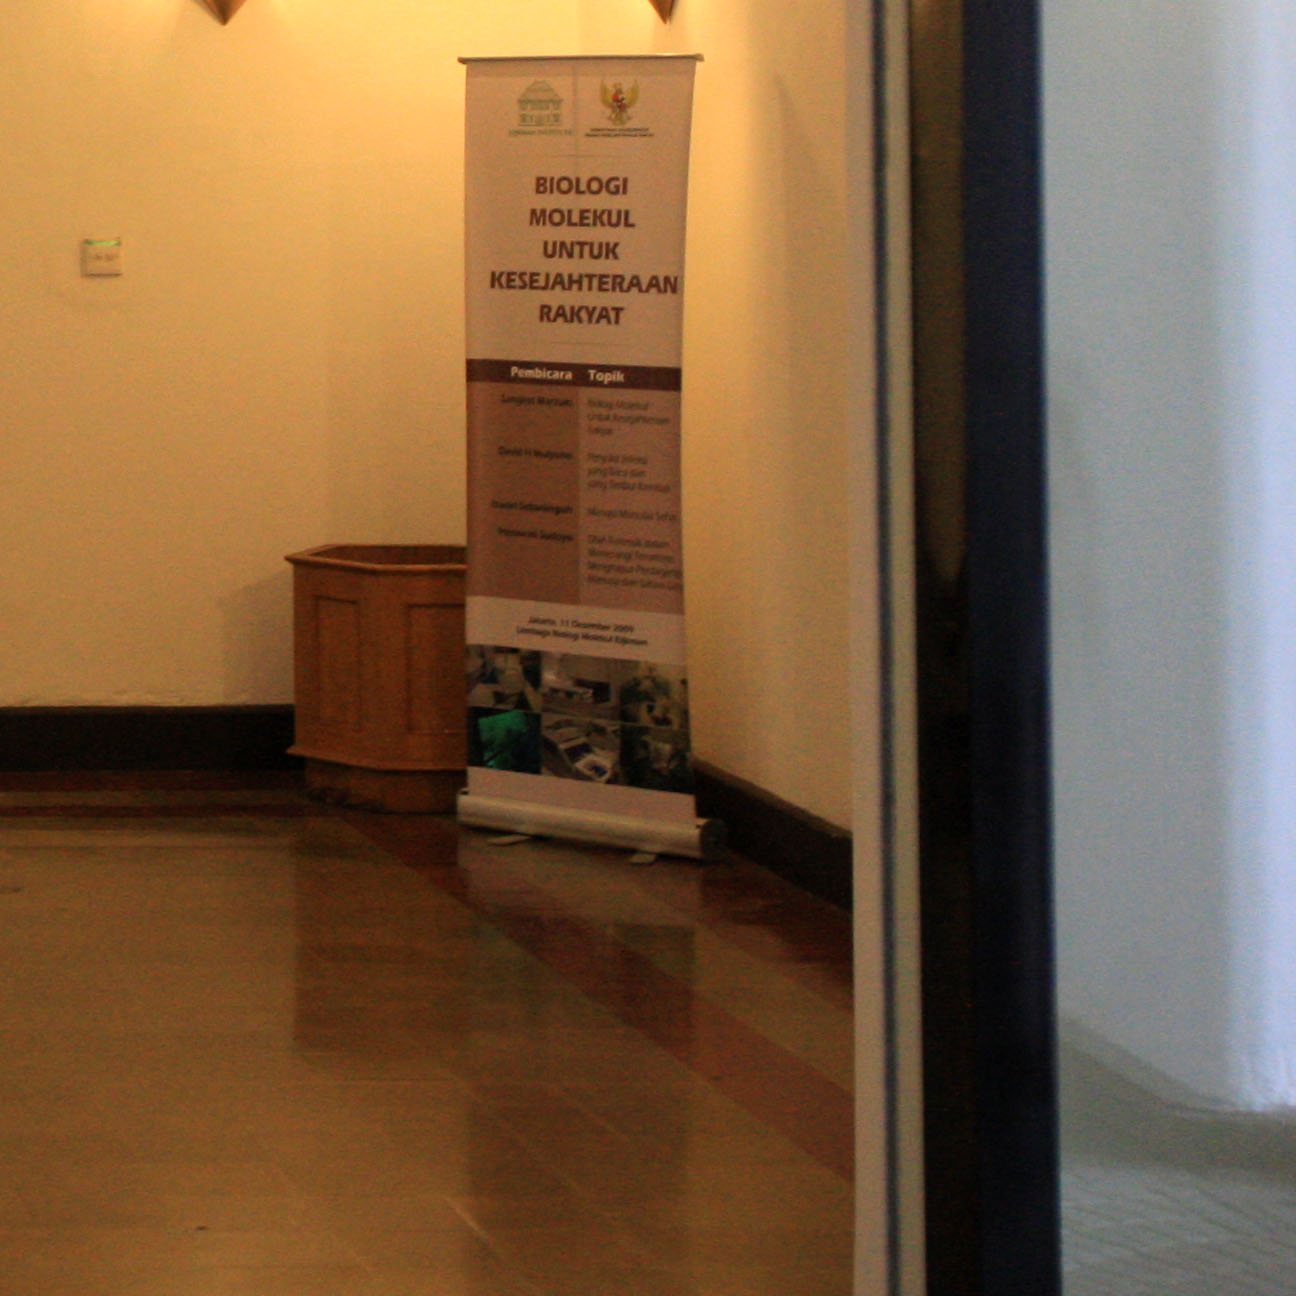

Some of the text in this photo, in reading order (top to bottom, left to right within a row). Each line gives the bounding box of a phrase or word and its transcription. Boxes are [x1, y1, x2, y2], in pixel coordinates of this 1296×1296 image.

[534, 176, 630, 196] BIOLOGI
[528, 207, 637, 228] MOLEKUL
[542, 240, 620, 260] UNTUK
[489, 270, 679, 295] KESEJAHTERAAN
[539, 304, 625, 325] RAKYAT
[510, 365, 625, 385] Pembicara Topik
